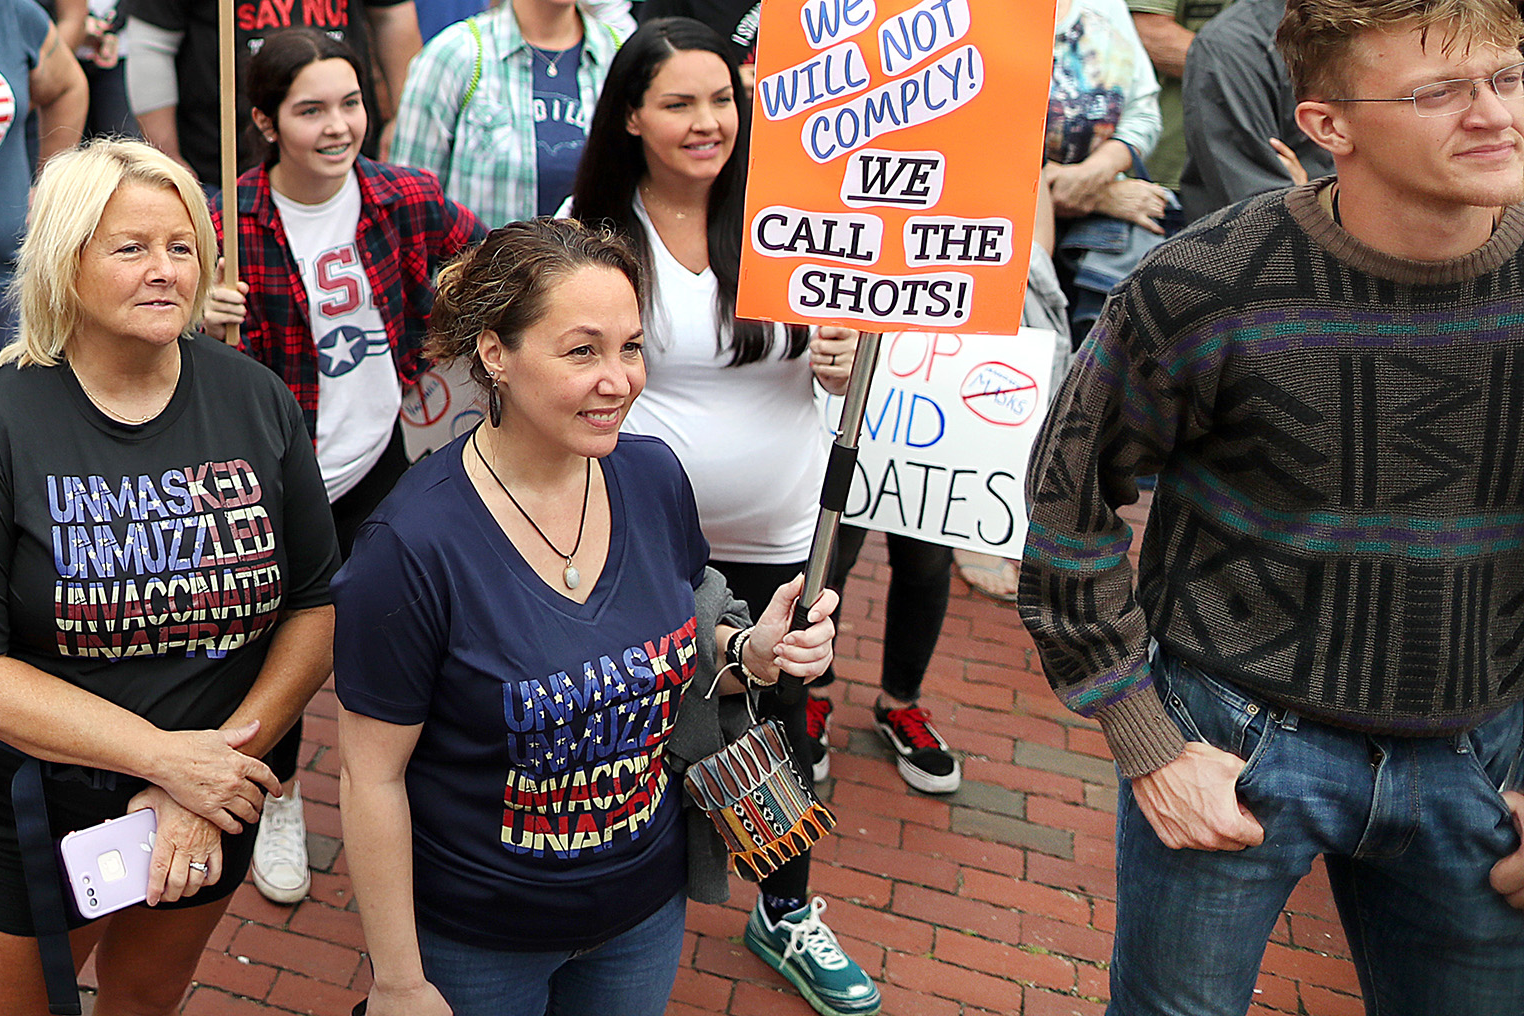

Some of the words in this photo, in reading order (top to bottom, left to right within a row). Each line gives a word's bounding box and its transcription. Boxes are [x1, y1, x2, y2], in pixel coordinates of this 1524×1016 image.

[762, 49, 867, 117] WILL
[810, 47, 976, 160] COMPLY!
[859, 155, 940, 197] WE
[757, 214, 874, 261] CALL
[911, 224, 1005, 262] THE
[800, 270, 968, 319] SHOTS!
[887, 331, 963, 382] OP
[969, 372, 1028, 416] MASKS
[46, 458, 263, 524] UNMASKED
[842, 458, 1016, 546] DATES
[51, 505, 277, 580] UNMUZZLED
[54, 560, 283, 633] UNVACCINATED
